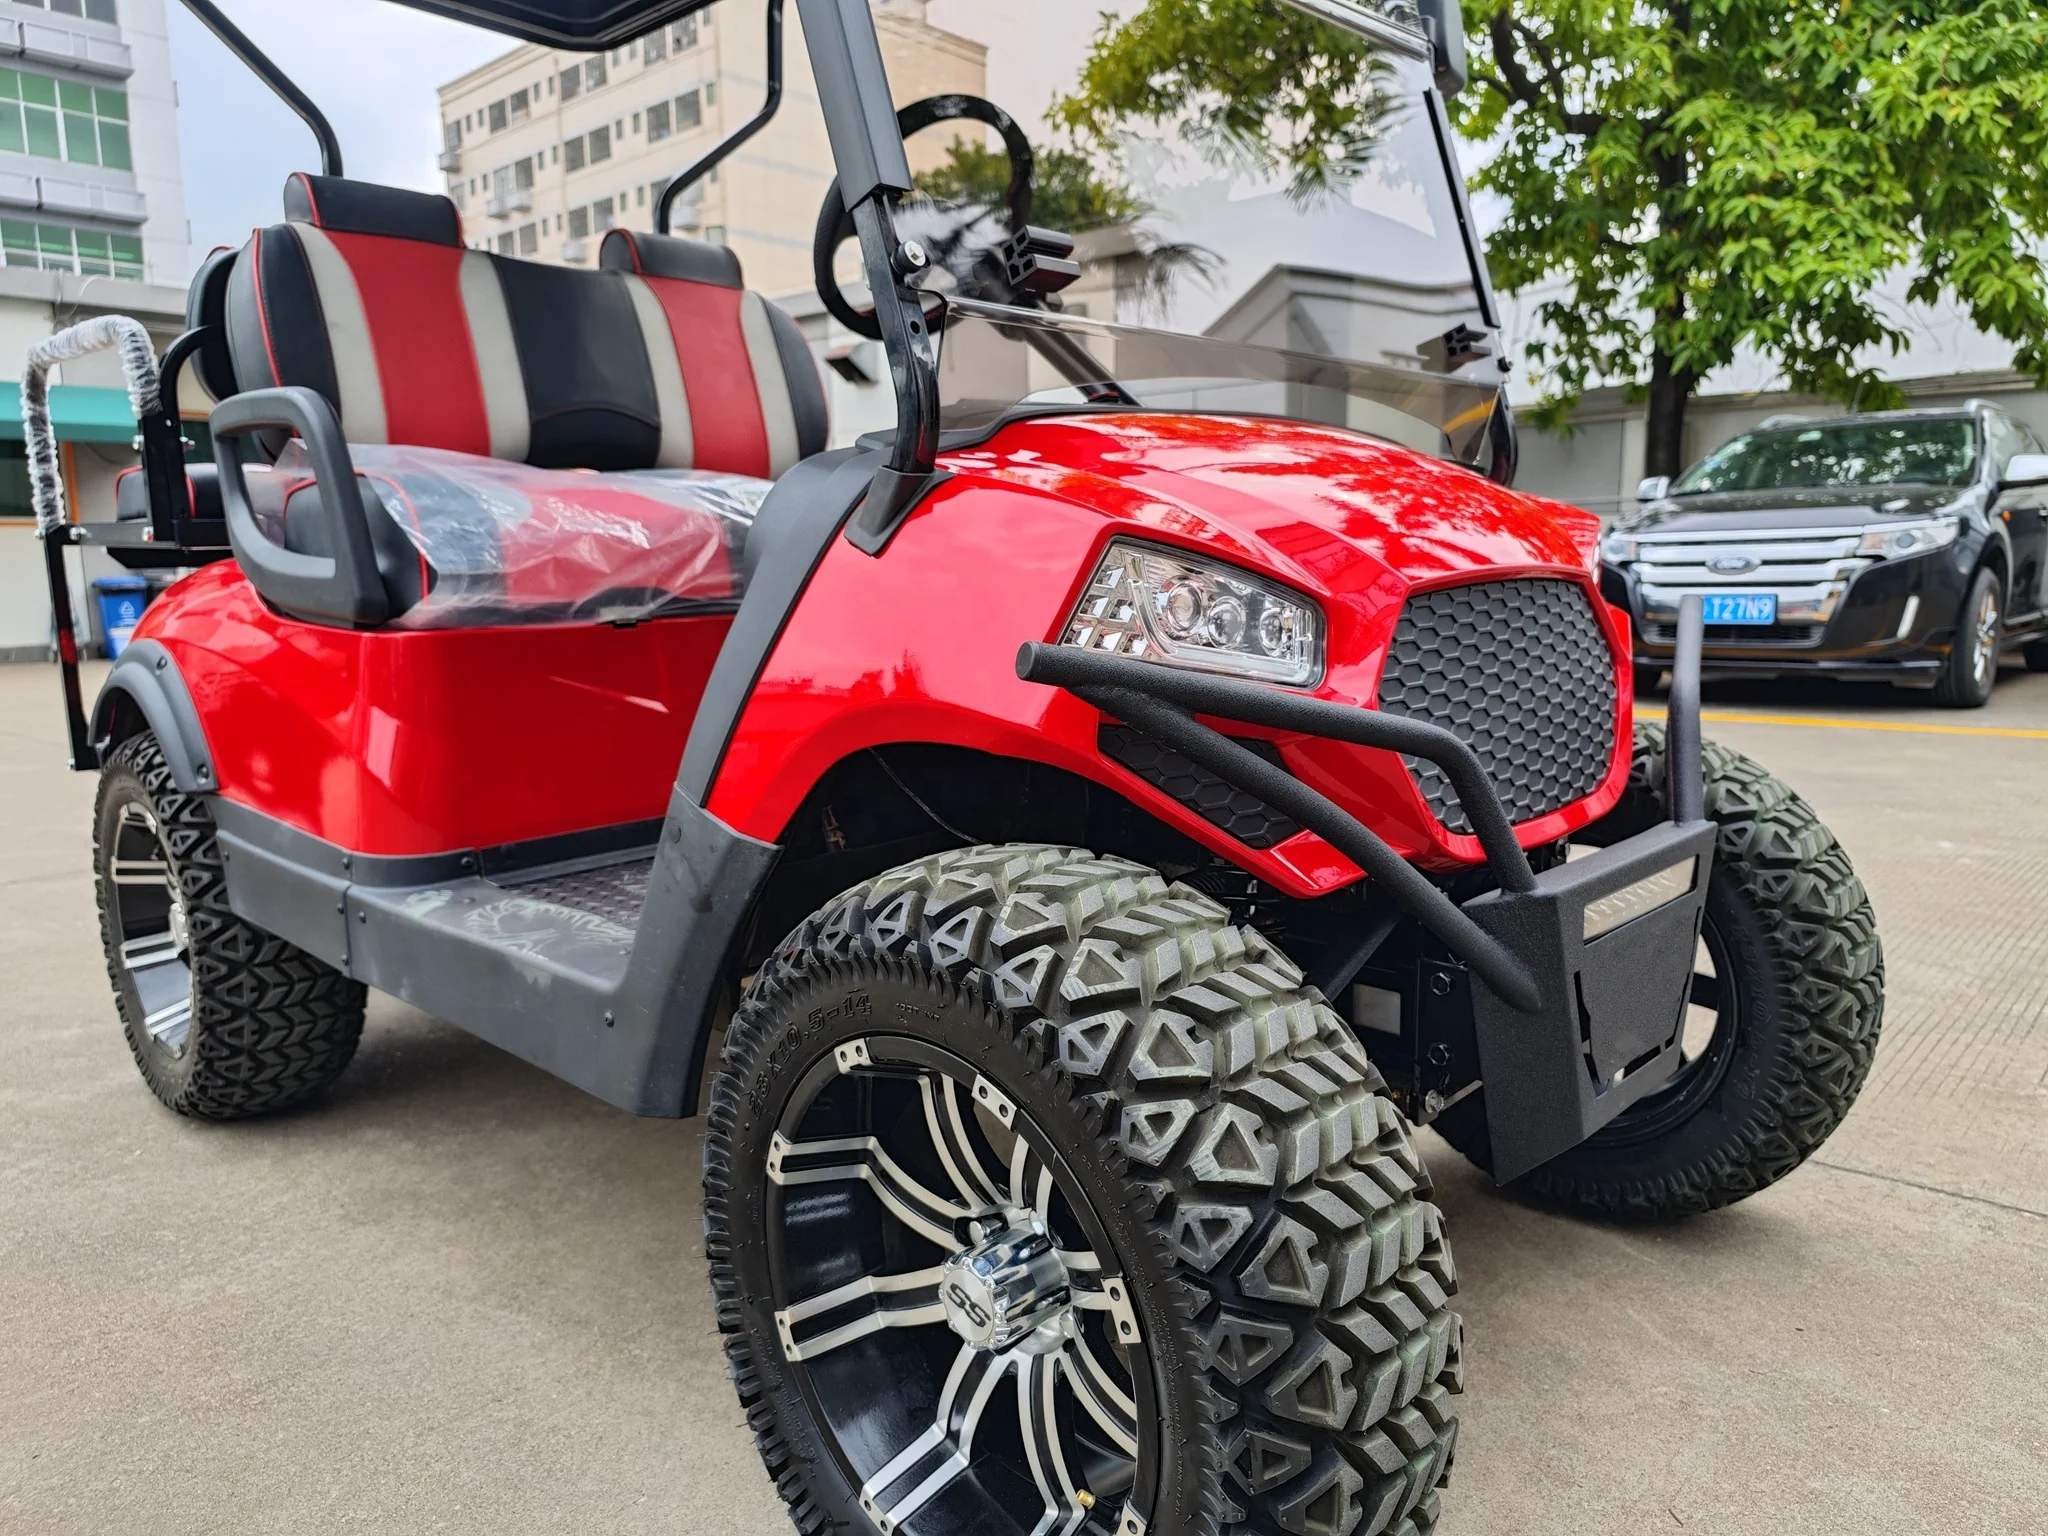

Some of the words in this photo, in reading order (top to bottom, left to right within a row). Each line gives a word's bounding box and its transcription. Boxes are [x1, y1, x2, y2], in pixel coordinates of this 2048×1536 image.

[1711, 597, 1771, 619] T27N9
[749, 992, 872, 1120] 23X10.5-14
[946, 1282, 992, 1328] SS
